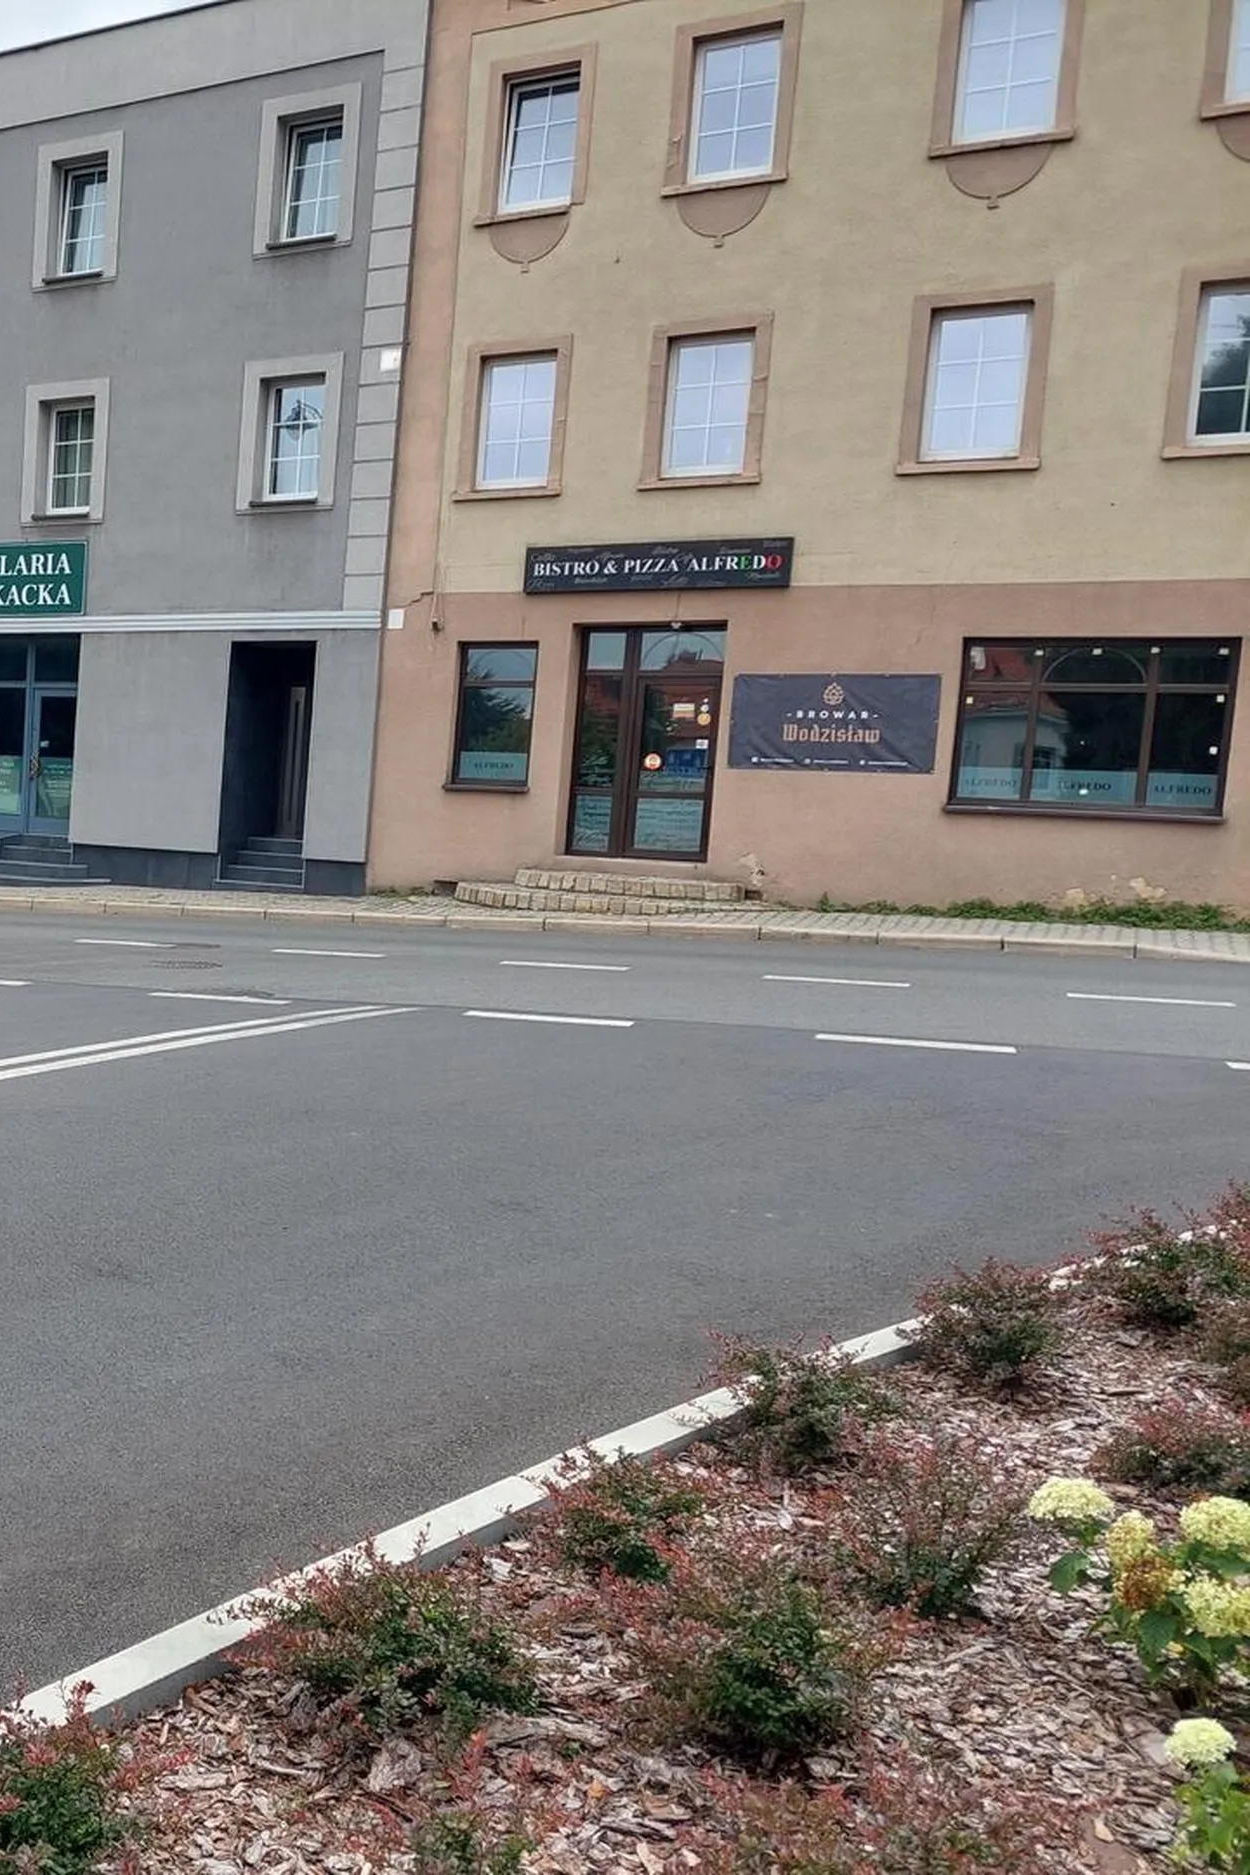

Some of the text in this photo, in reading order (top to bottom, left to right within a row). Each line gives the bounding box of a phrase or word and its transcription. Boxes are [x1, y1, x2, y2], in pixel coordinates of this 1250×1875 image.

[534, 560, 600, 576] BISTRO
[603, 559, 618, 574] &
[624, 557, 679, 573] PIZZA
[686, 554, 783, 571] ALFREDO
[796, 711, 869, 719] BROWAR
[782, 724, 881, 744] Wodzisław
